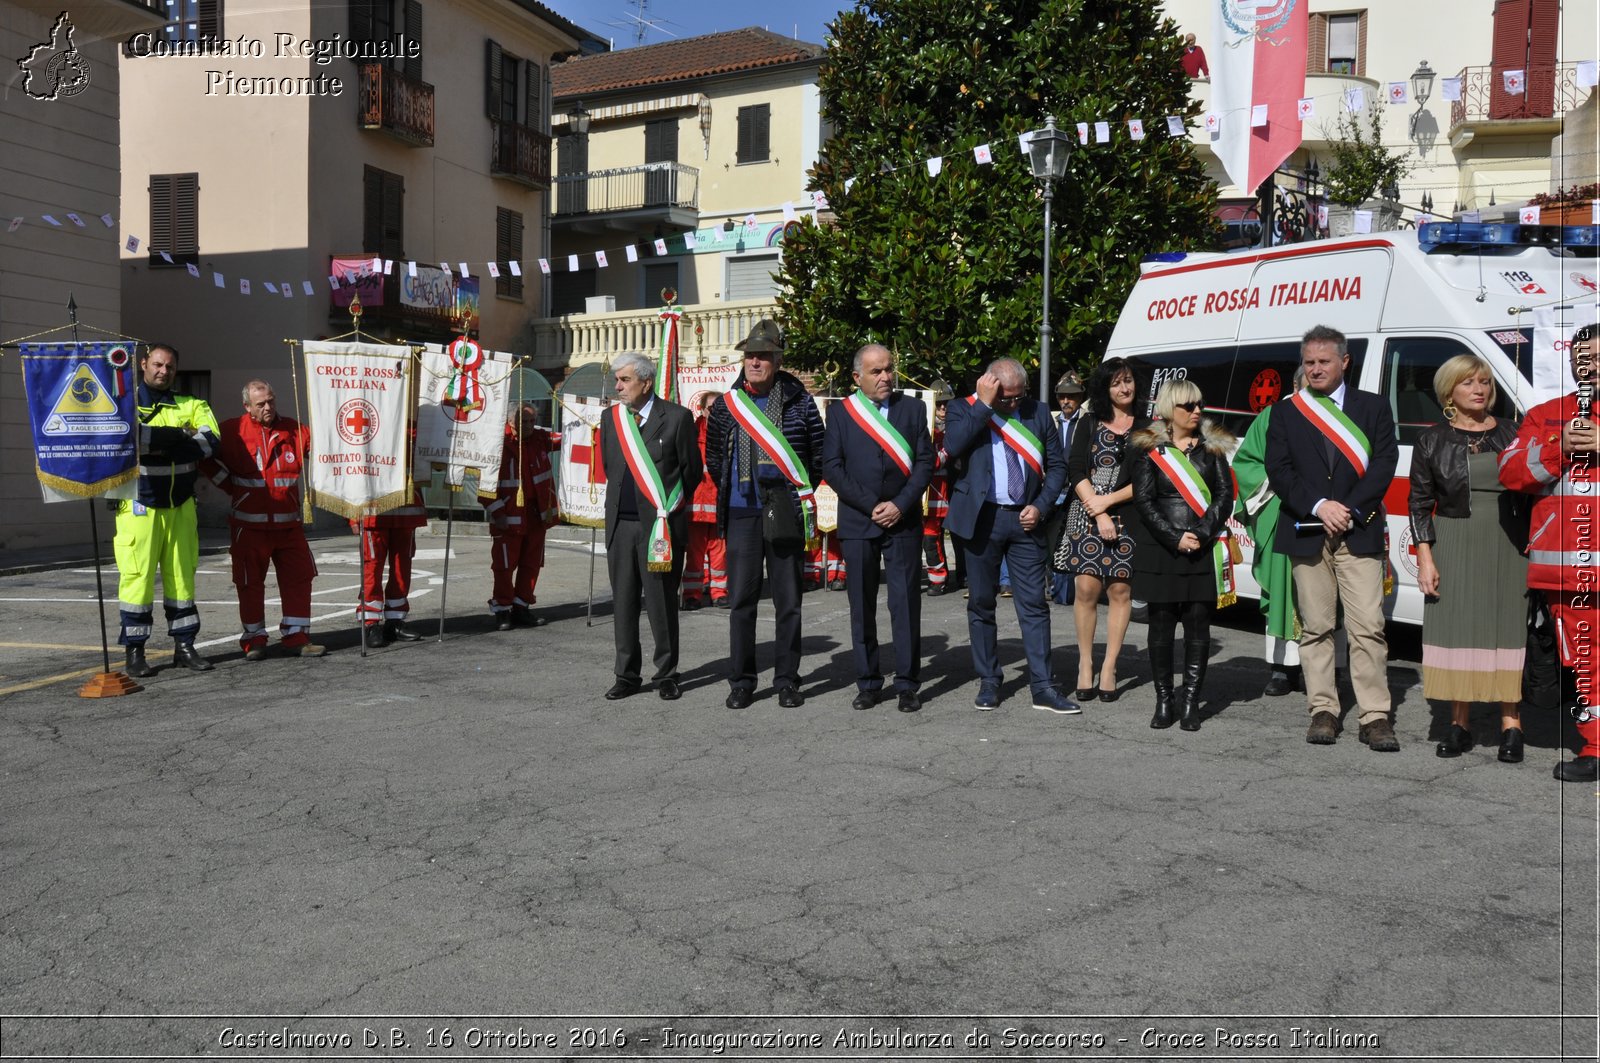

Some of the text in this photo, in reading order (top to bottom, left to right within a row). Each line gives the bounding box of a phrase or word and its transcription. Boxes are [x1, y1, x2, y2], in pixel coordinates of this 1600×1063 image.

[1503, 270, 1534, 282] 118
[1147, 276, 1361, 321] CROCE ROSSA ITALIANA
[316, 366, 401, 380] CROCE ROSSA
[678, 365, 737, 374] ROCE ROSSA
[331, 379, 387, 391] ITALIANA
[682, 375, 726, 384] ITALIANA
[71, 424, 124, 432] EAGLE SECURITY
[446, 429, 476, 440] GRUPPO
[457, 440, 464, 448] DI
[418, 447, 473, 460] VILLAFRANCA
[319, 453, 397, 466] COMITATO LOCALE
[333, 466, 380, 477] DI CANELLI
